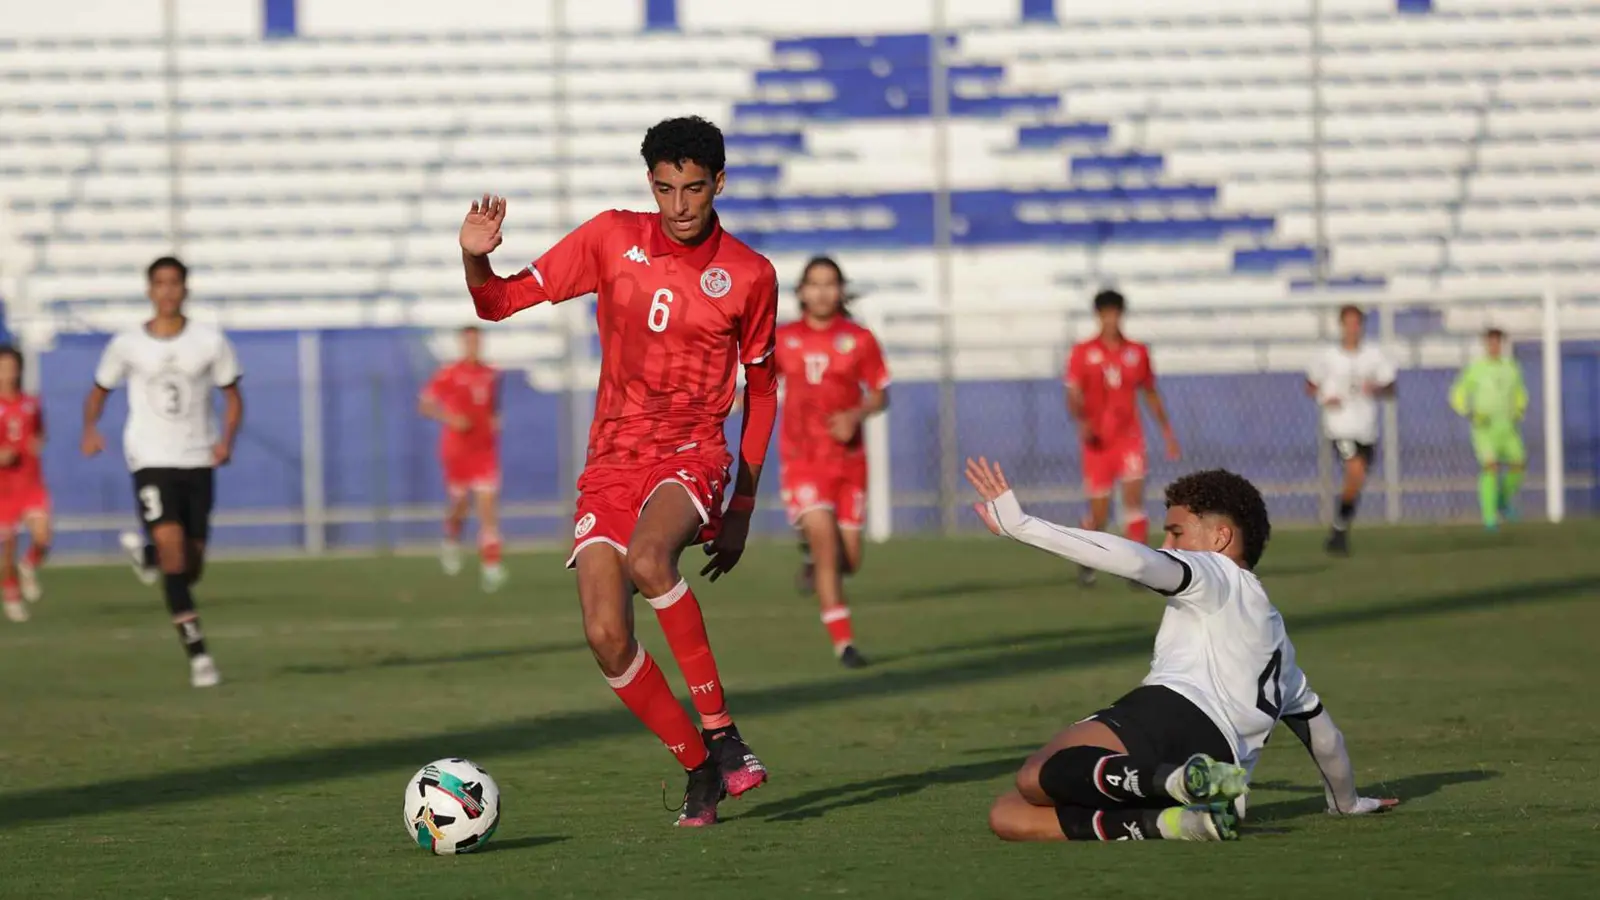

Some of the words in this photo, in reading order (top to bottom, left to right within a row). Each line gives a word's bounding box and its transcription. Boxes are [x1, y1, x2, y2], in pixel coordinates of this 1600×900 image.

[648, 288, 674, 332] 6
[139, 485, 163, 522] 3
[690, 680, 715, 695] FTF
[1256, 647, 1283, 722] 4
[664, 742, 686, 754] TF
[1106, 774, 1122, 786] 4
